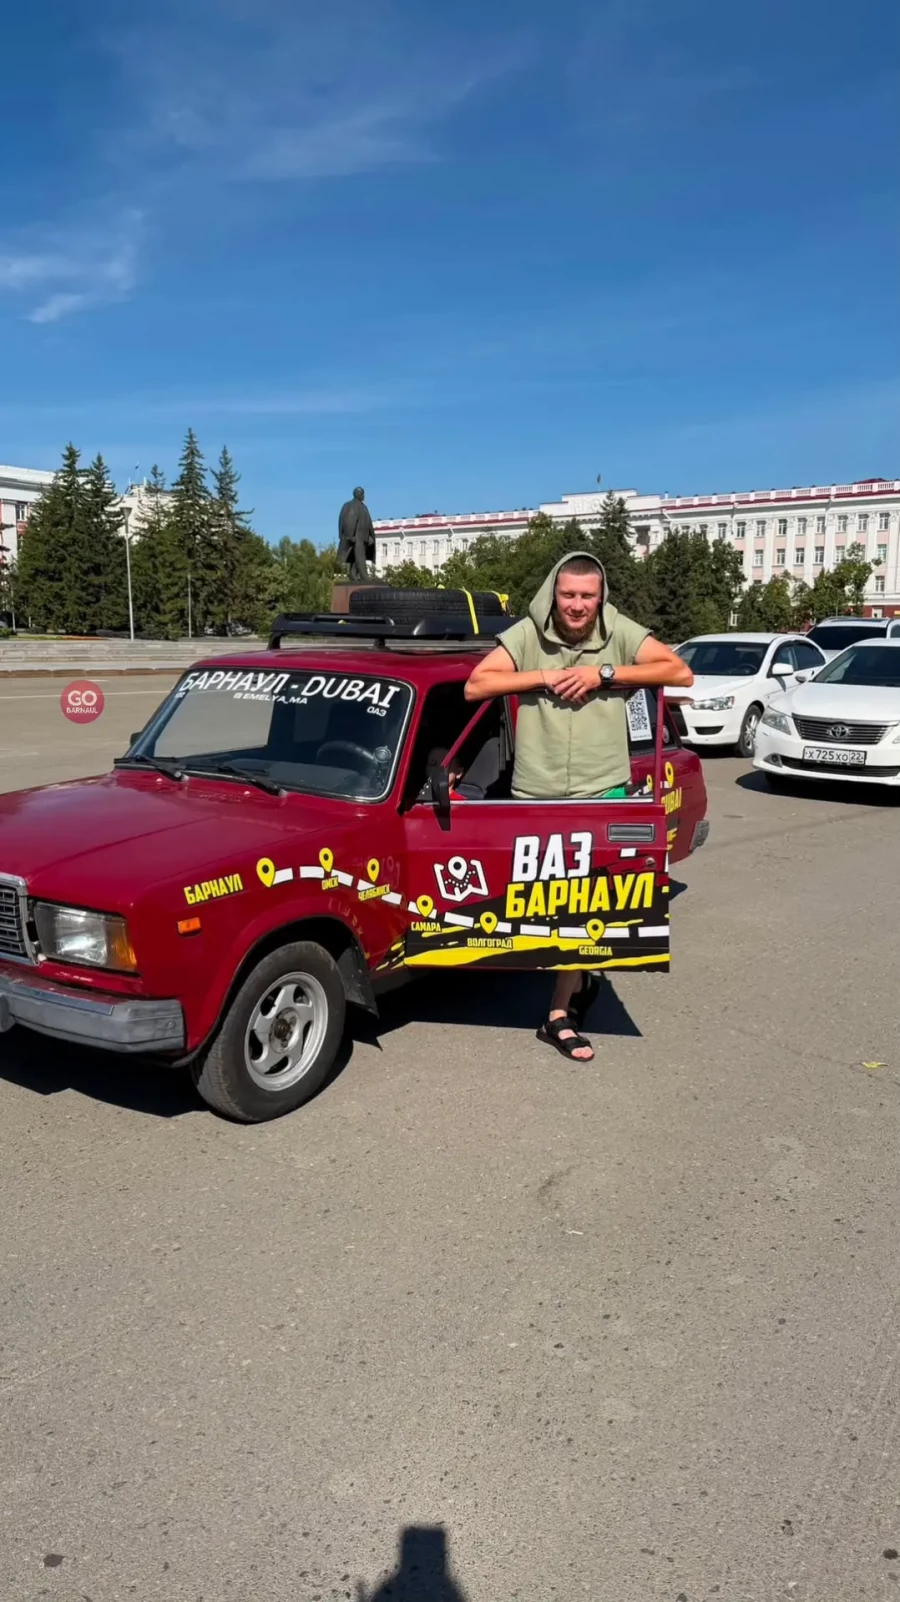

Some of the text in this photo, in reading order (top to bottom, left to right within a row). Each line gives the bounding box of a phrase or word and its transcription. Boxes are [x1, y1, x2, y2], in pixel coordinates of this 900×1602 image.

[178, 671, 290, 694] БАРНАУЛ
[301, 676, 400, 708] DUBAI
[512, 832, 592, 882] ВАЗ
[184, 873, 243, 905] БАРНАУЛ
[505, 872, 655, 918] БАРНАУЛ
[411, 922, 441, 932] САМАРА
[467, 937, 513, 949] ВОЛГОГРАД
[579, 945, 613, 956] GEORGIA
